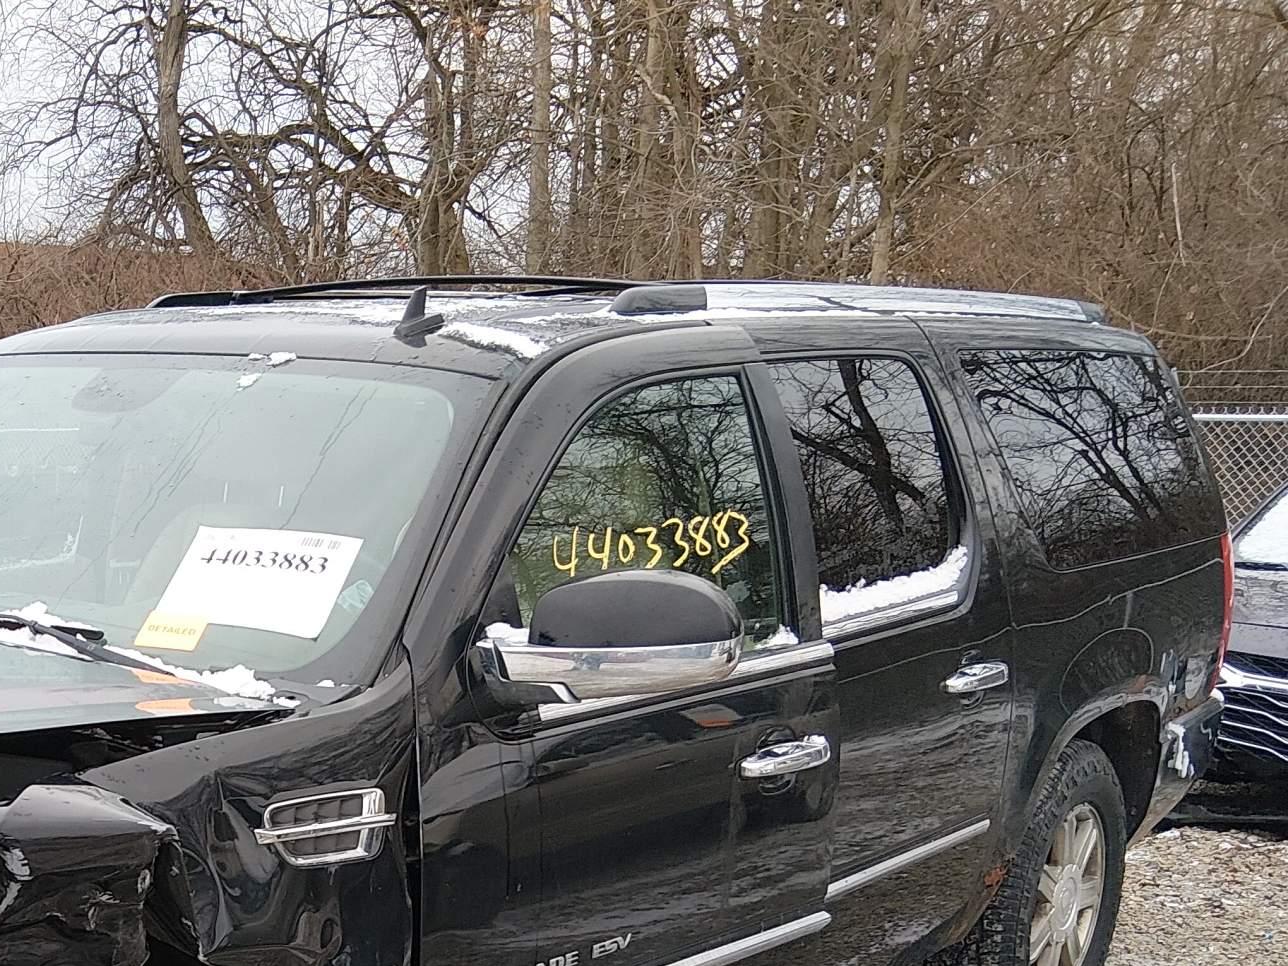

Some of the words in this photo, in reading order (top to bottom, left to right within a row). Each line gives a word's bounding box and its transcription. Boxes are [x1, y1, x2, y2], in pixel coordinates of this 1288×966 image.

[553, 509, 750, 577] 44033883
[202, 549, 328, 574] 44033883
[592, 933, 632, 959] ESV
